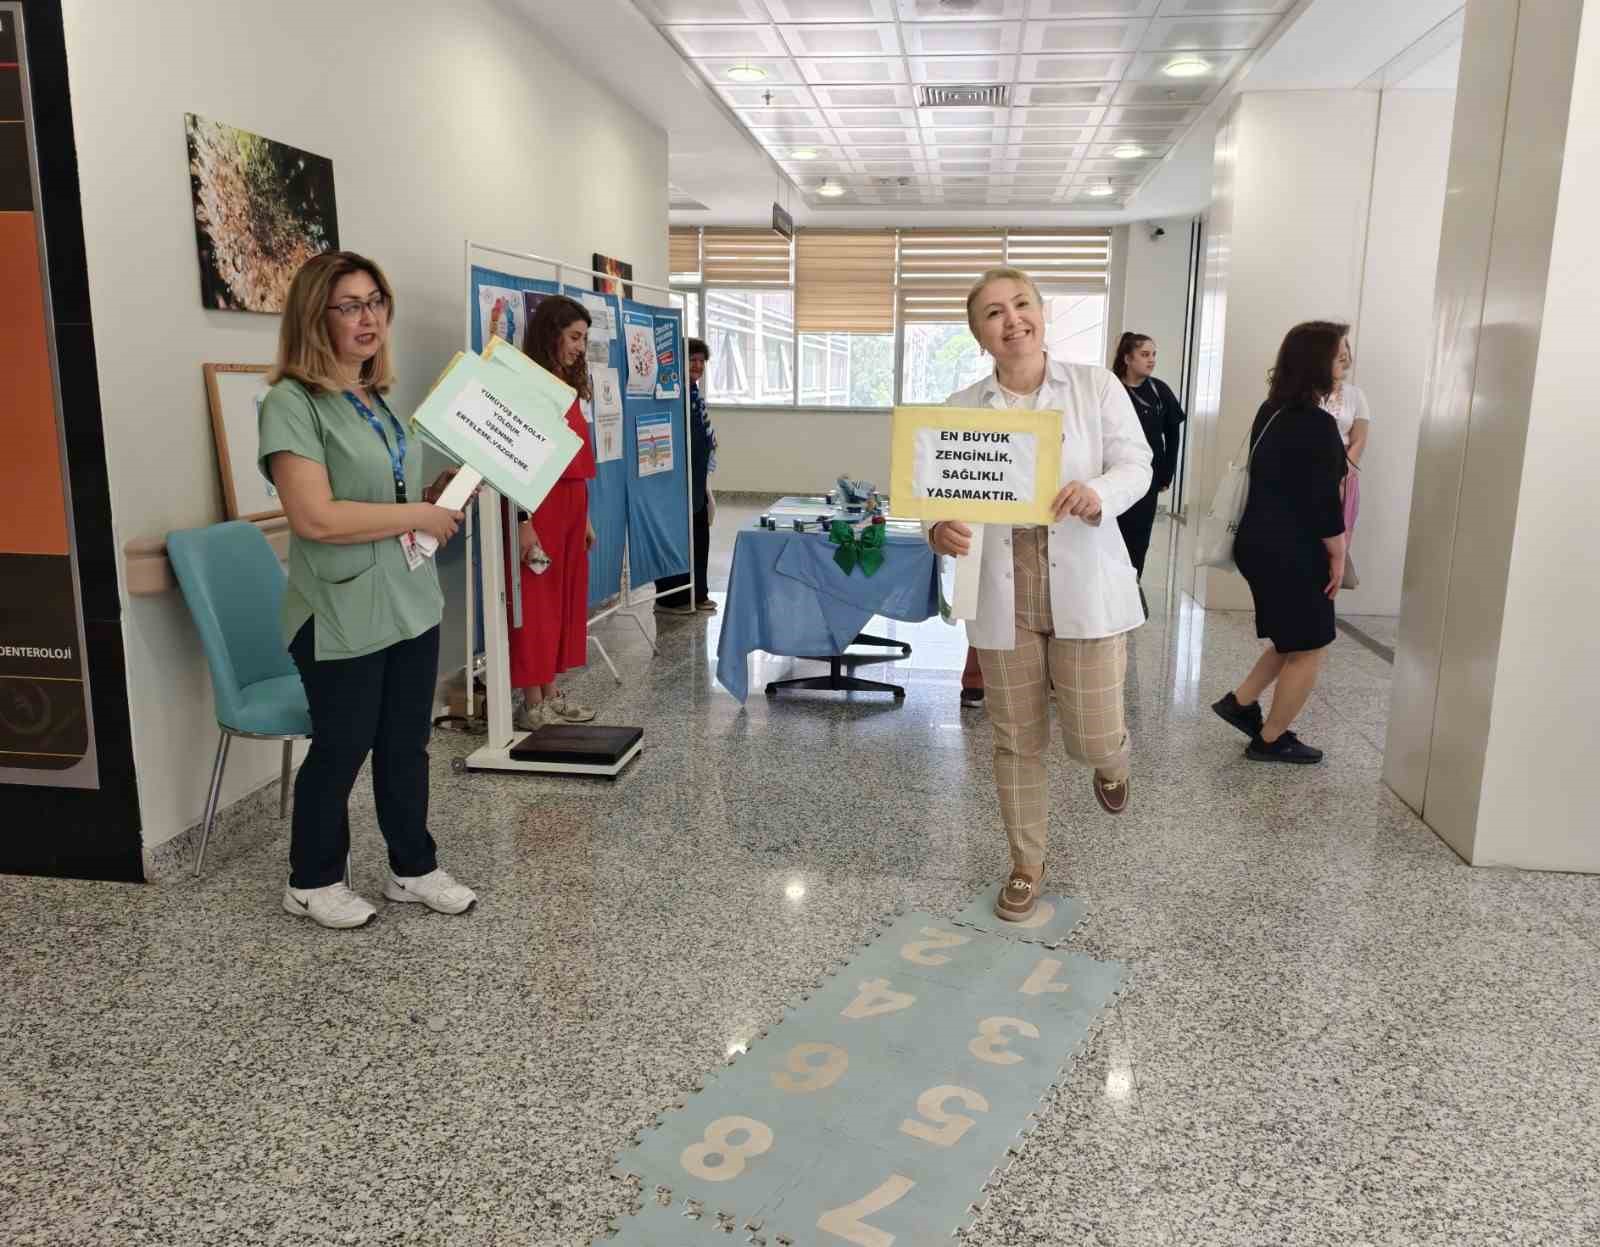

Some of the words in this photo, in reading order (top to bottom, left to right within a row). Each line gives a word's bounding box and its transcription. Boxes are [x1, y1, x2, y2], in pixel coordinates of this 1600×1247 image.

[523, 423, 546, 442] KOLAY
[940, 431, 959, 441] EN
[963, 430, 1010, 443] BÜYÜK
[935, 449, 1013, 464] ZENGİNLİK,
[942, 469, 1004, 481] SAĞLIKLI
[900, 926, 972, 967] 2
[1017, 958, 1072, 994] 1
[840, 977, 917, 1019] 4
[968, 1015, 1040, 1065] 3
[900, 1084, 990, 1147] 5
[680, 1115, 775, 1181] 8
[816, 1173, 916, 1247] 7
